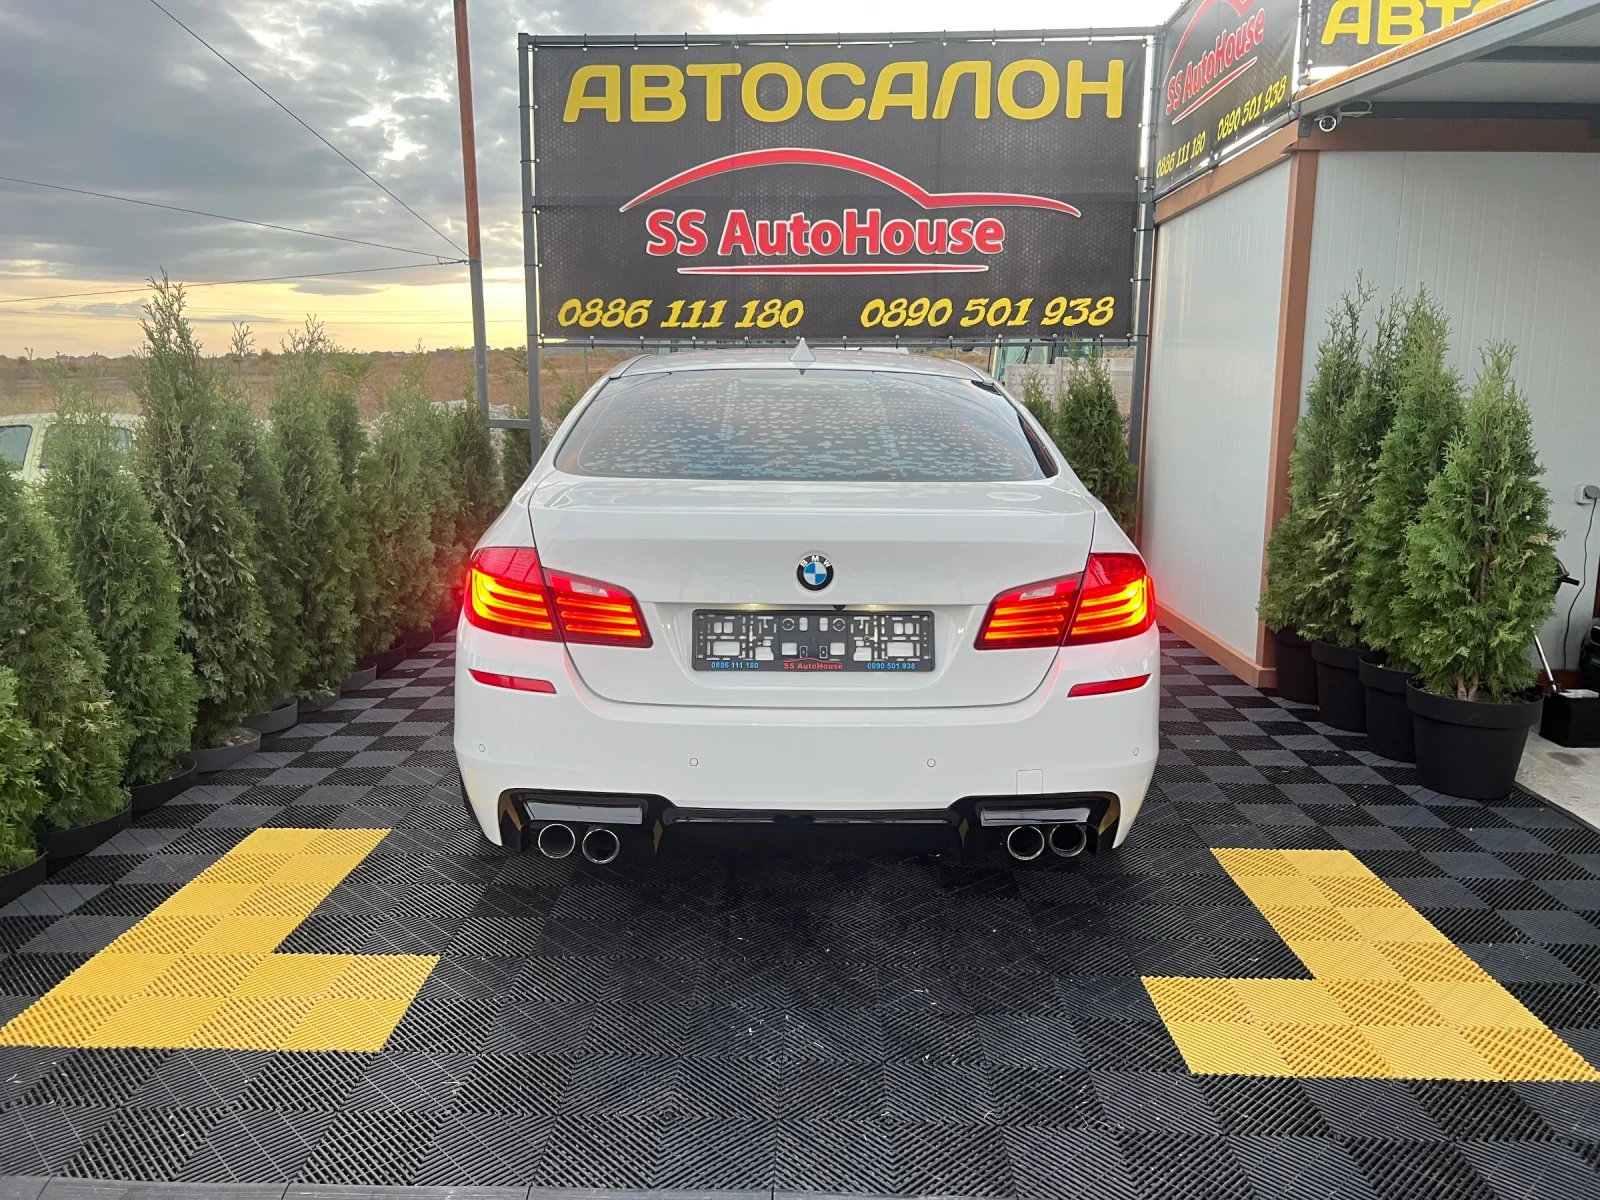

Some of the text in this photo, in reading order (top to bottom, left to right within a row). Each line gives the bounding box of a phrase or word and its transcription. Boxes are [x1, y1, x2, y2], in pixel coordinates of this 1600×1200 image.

[1320, 0, 1501, 45] АВТ
[1165, 8, 1266, 116] SS AutoHouse
[562, 59, 1124, 123] АВТОСАЛОН
[1217, 75, 1288, 142] 0890 501 938
[1156, 131, 1206, 179] 0886 111 180
[645, 209, 1006, 257] SS AutoHouse
[557, 298, 804, 328] 0886 111 180
[860, 296, 1115, 328] 0890 501 938
[800, 555, 832, 568] BMW
[710, 661, 759, 669] 0886 111 180
[783, 662, 844, 670] SS AutoHouse
[866, 662, 916, 670] 0890 501 938
